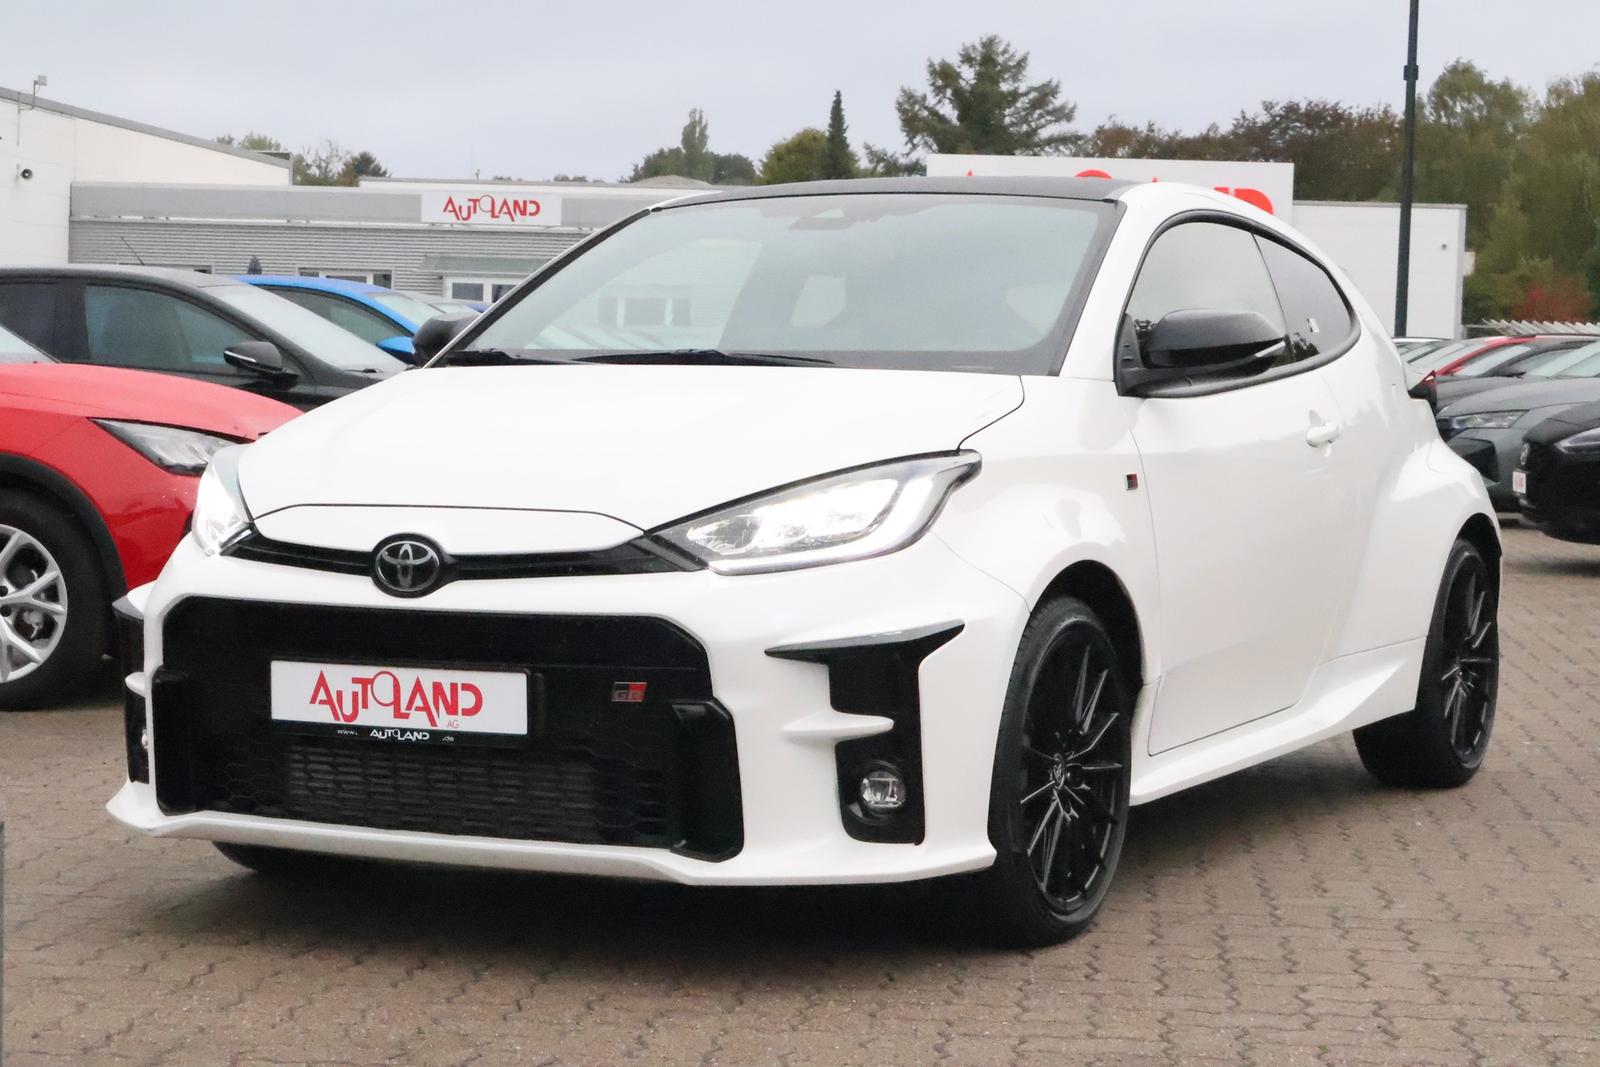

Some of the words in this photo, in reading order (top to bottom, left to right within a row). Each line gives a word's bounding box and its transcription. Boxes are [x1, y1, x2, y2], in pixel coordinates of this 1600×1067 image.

[443, 194, 541, 222] AUTOLAND
[309, 669, 483, 727] AUTOLAND
[447, 720, 460, 729] AG
